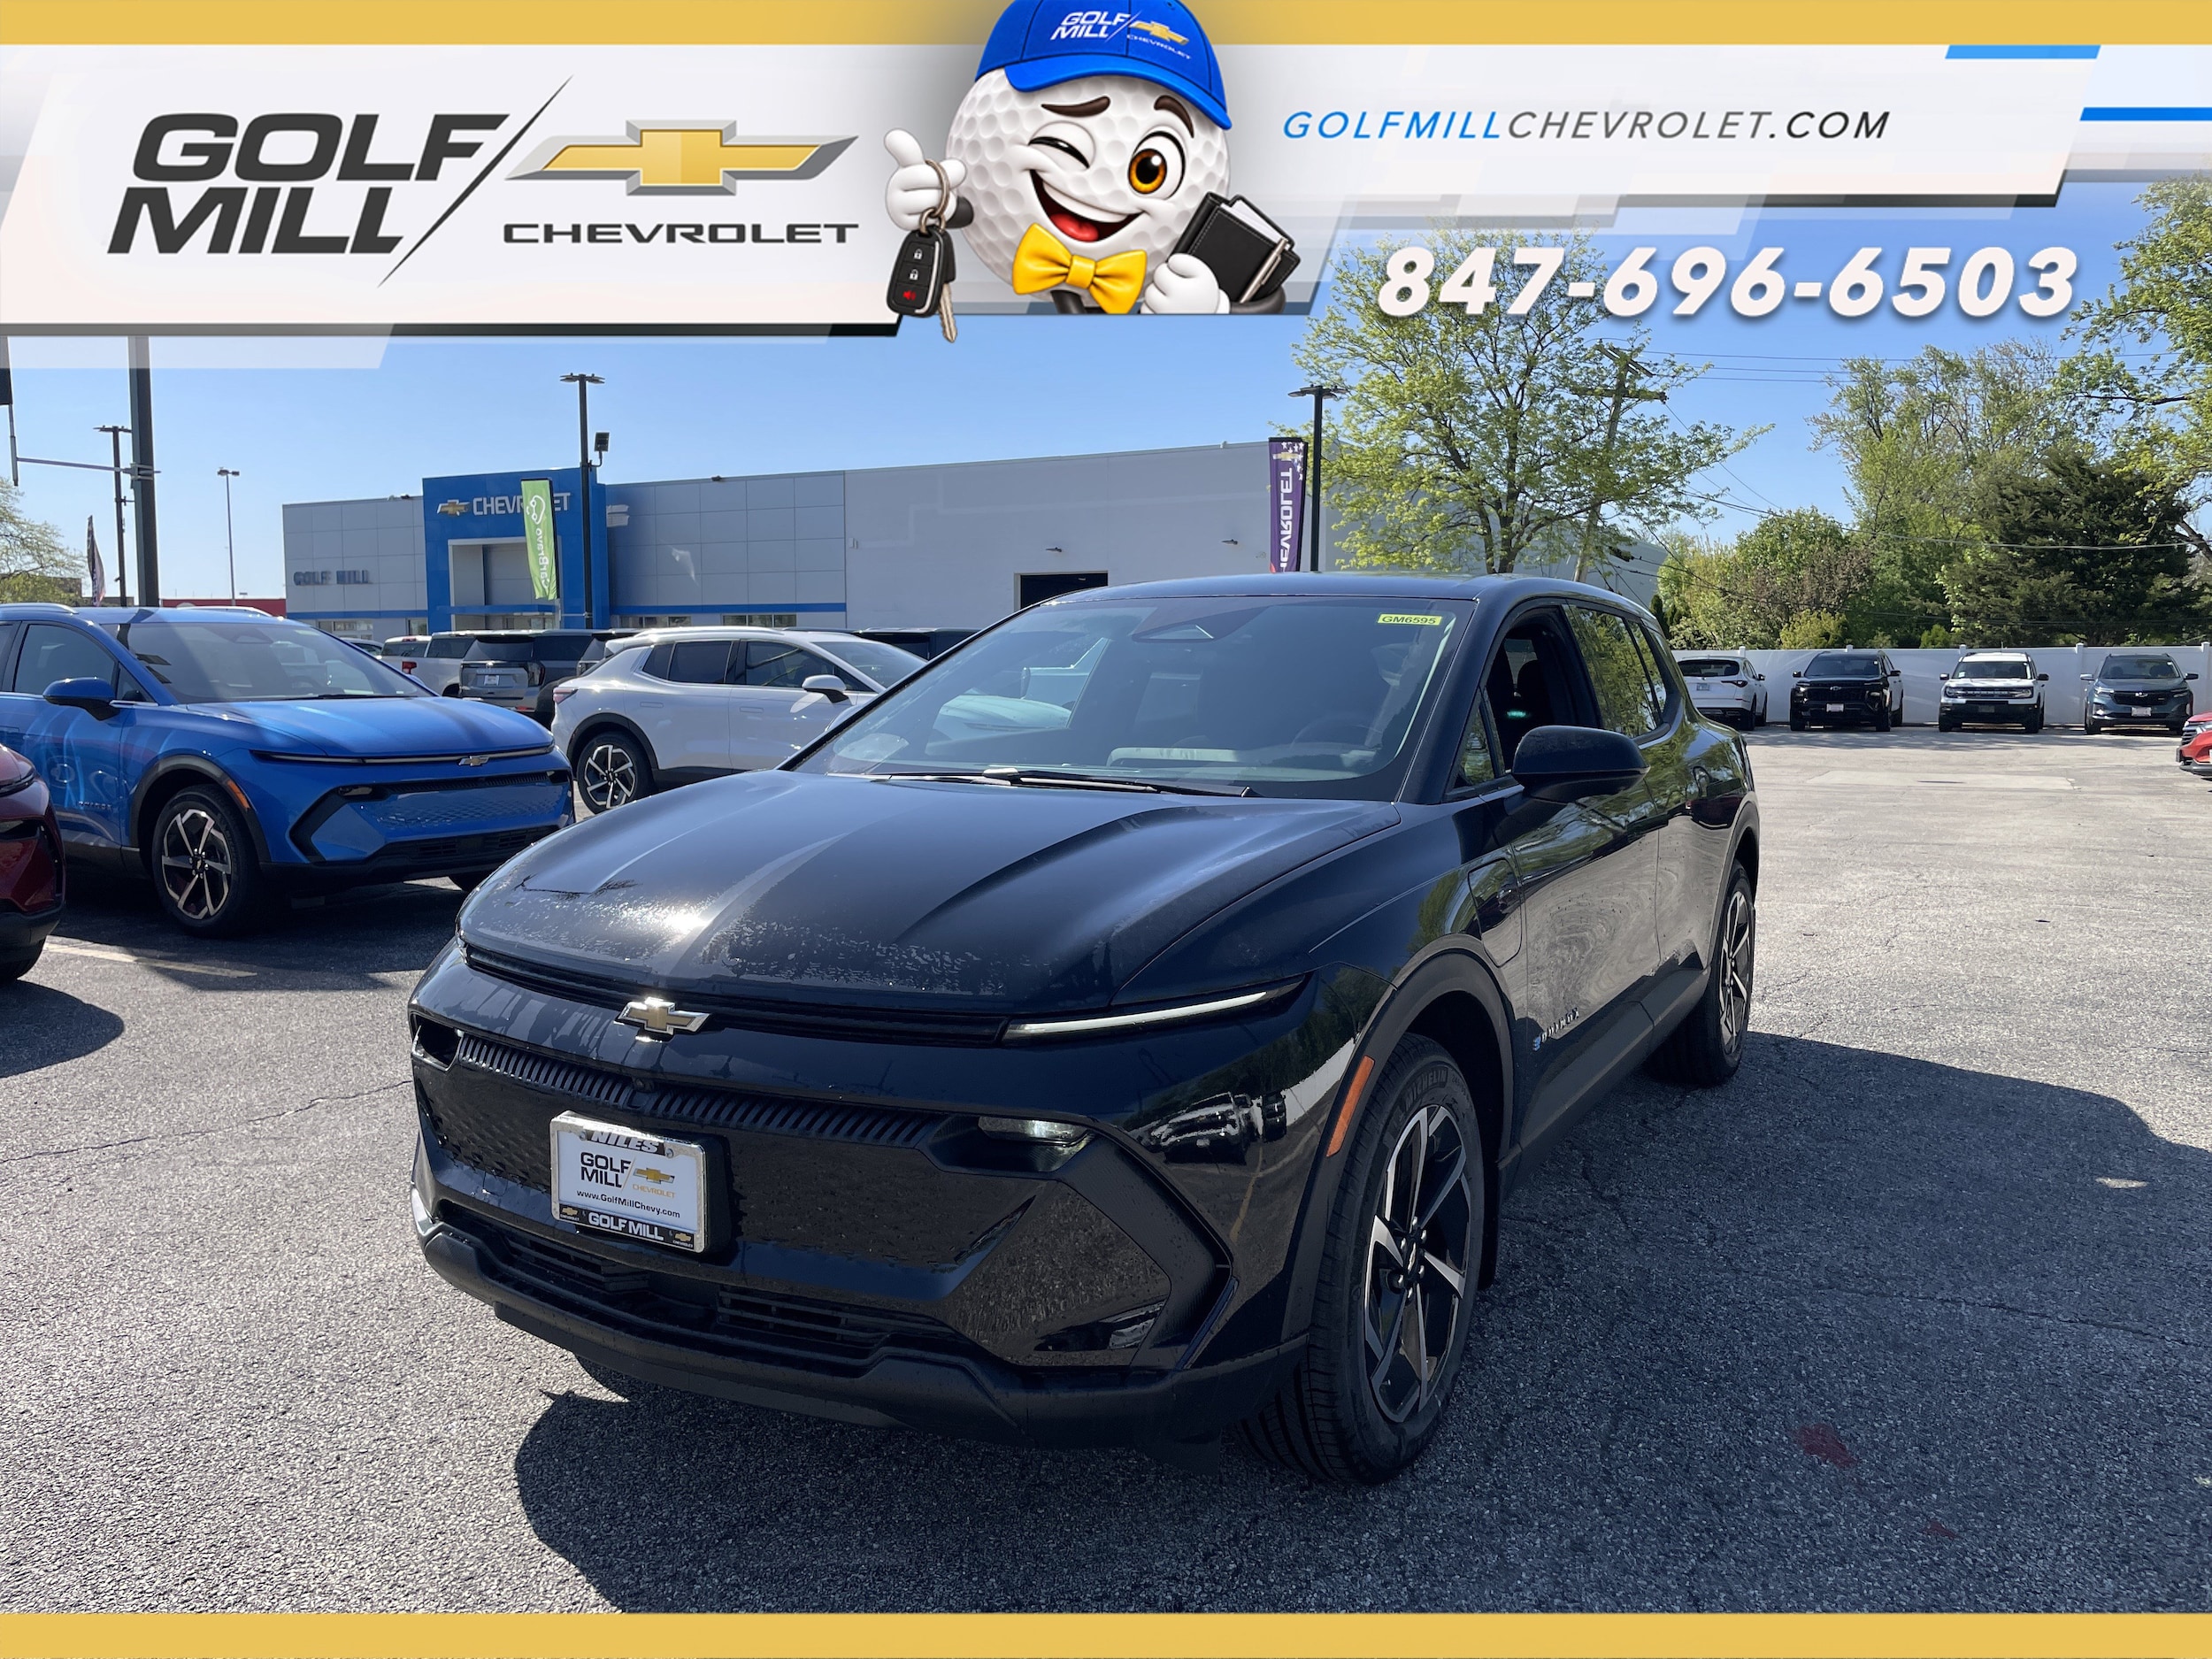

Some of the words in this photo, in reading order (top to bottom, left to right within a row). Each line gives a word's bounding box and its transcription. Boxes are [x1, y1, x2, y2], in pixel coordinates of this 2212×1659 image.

[293, 571, 331, 586] GOLF
[1382, 616, 1437, 625] GM6595
[591, 1132, 659, 1153] NILES
[580, 1151, 632, 1174] GOLF
[580, 1166, 623, 1188] MILL
[632, 1183, 677, 1199] CHEVROLET
[576, 1189, 680, 1219] www.GolfMillChevy.com
[588, 1211, 628, 1232] GOLF
[628, 1221, 664, 1241] MILL
